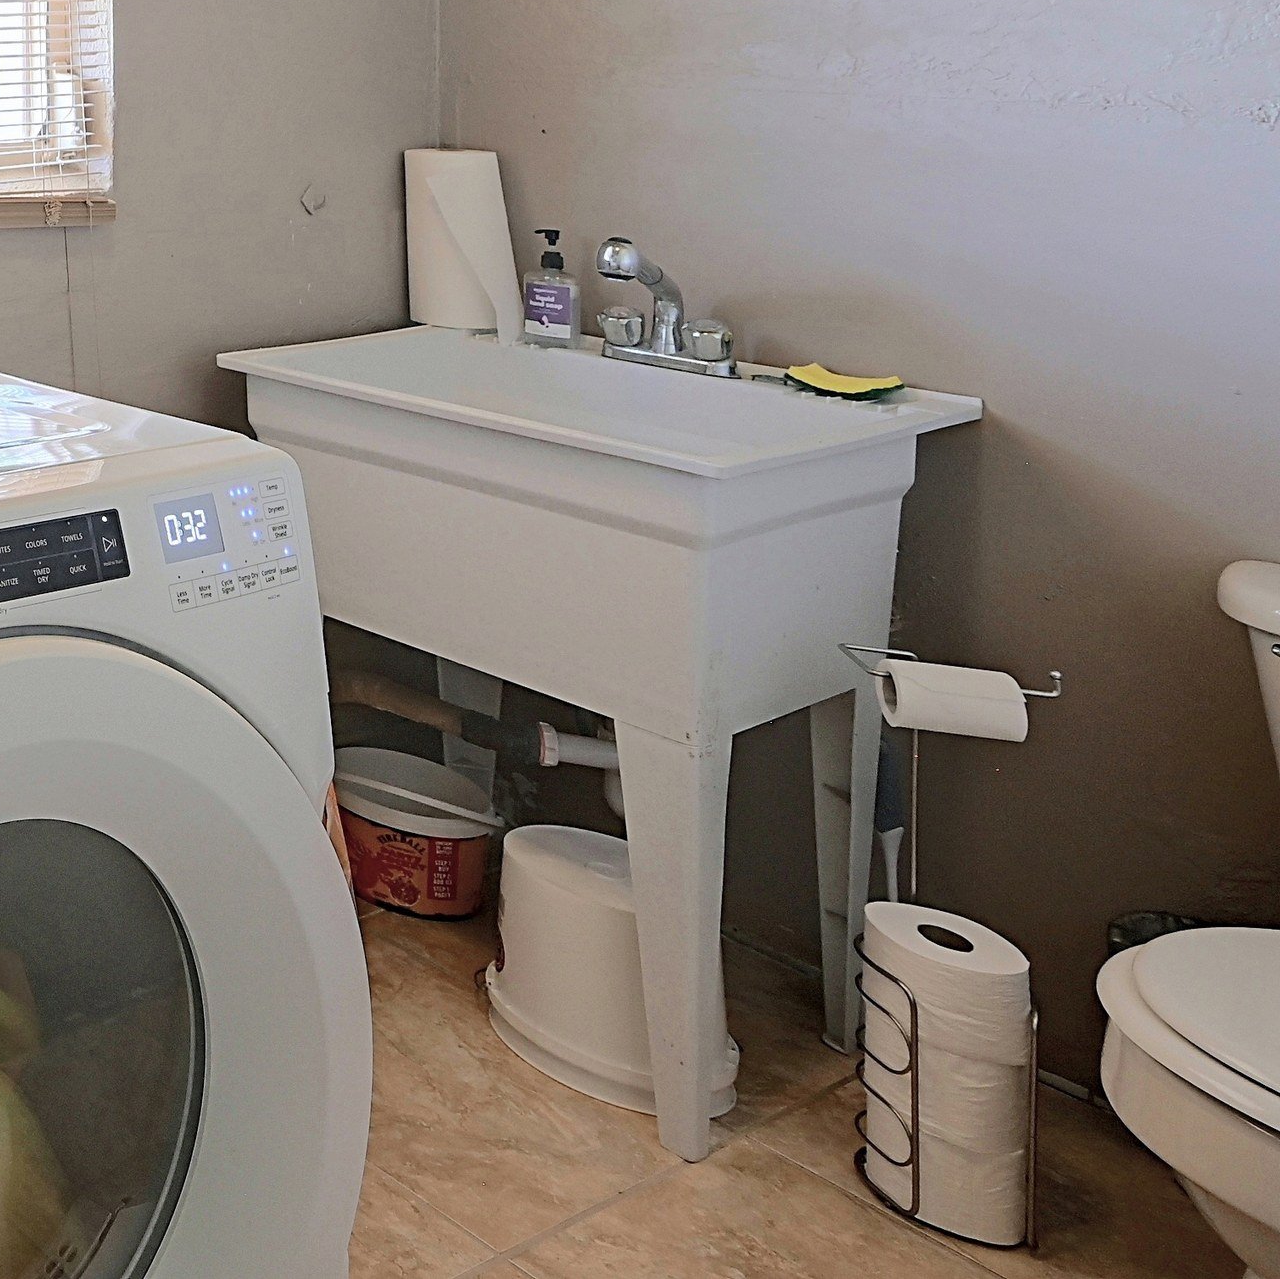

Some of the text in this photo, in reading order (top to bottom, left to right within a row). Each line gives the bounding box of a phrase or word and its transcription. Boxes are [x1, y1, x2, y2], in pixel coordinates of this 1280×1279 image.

[61, 533, 83, 543] TOWELS
[25, 539, 48, 549] COLORS
[33, 567, 50, 576] TIMED
[69, 564, 87, 574] QUICK
[37, 575, 49, 584] DRY
[221, 579, 233, 588] Cycle
